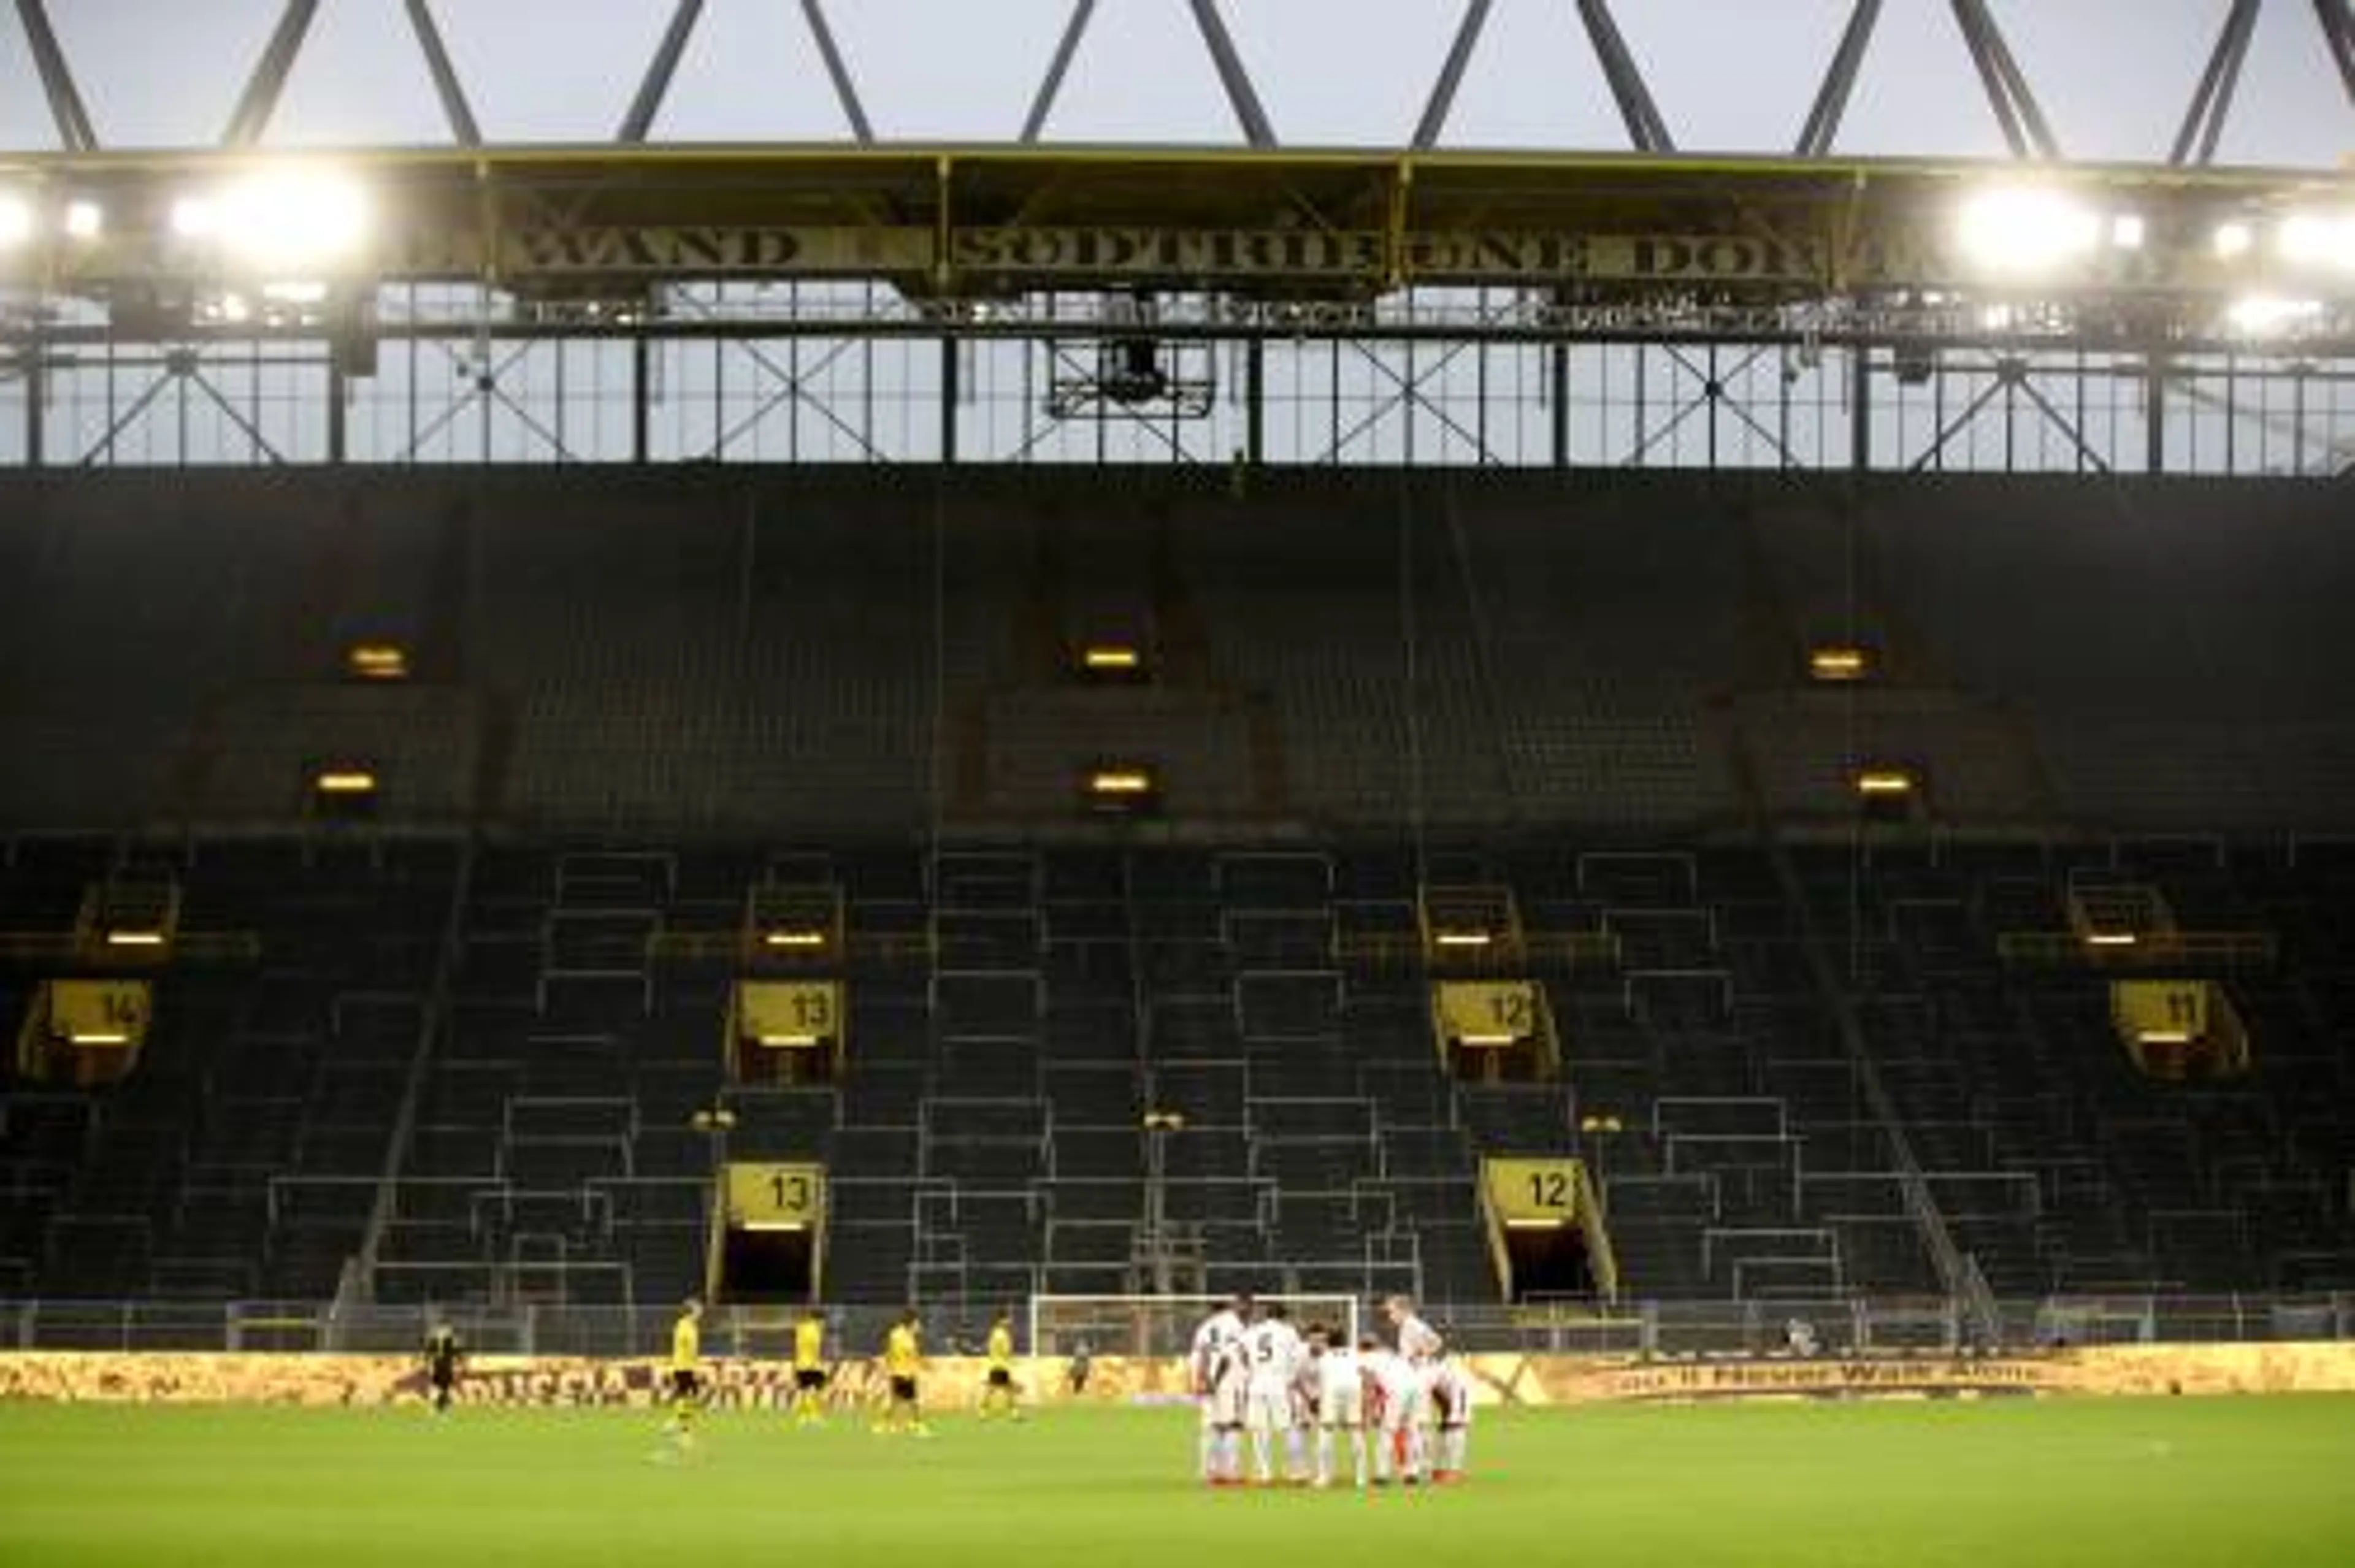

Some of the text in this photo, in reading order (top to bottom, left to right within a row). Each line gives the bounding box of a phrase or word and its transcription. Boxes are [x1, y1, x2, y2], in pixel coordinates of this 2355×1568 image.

[791, 992, 827, 1028] 13
[1489, 994, 1528, 1027] 12
[770, 1175, 808, 1210] 13
[1528, 1172, 1566, 1207] 12
